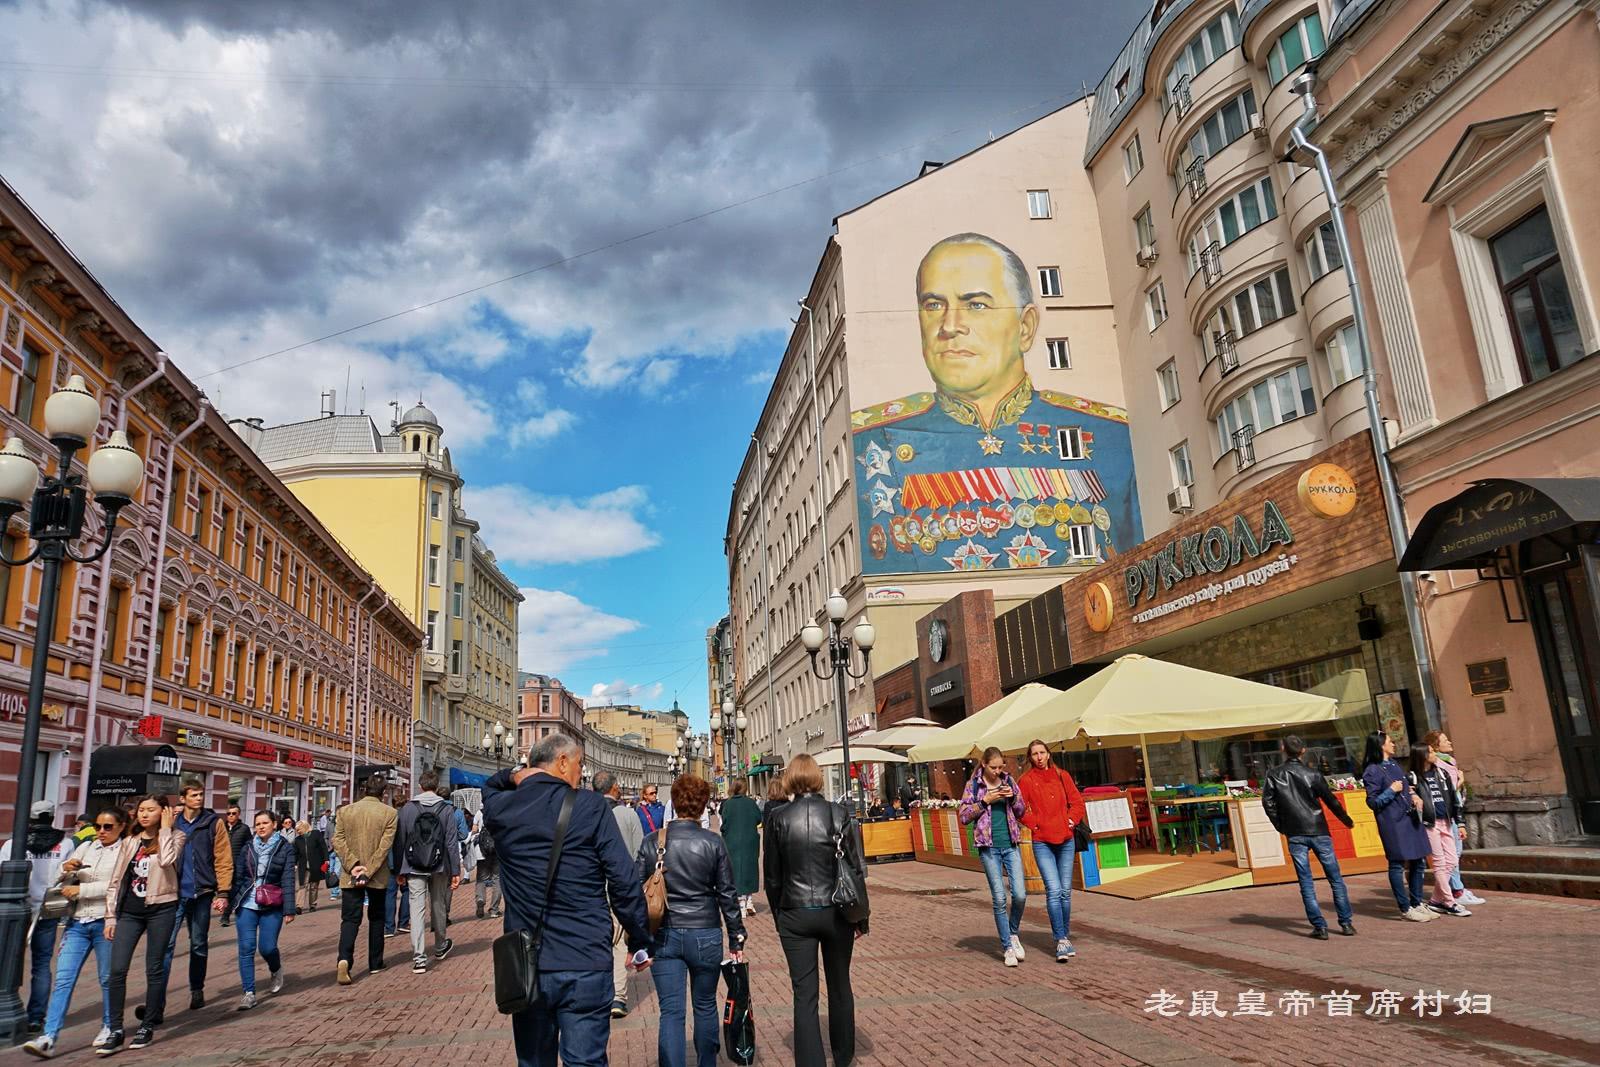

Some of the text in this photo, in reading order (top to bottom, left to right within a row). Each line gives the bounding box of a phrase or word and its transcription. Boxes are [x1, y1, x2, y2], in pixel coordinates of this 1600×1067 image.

[1309, 486, 1356, 495] РУККОЛА
[1531, 510, 1559, 525] зал
[1124, 500, 1294, 608] РУККОЛА
[1138, 554, 1291, 623] итальянское кафе для друзей
[930, 680, 953, 697] STARBUCKS
[0, 693, 27, 720] ирь
[158, 755, 183, 775] ТАТУ
